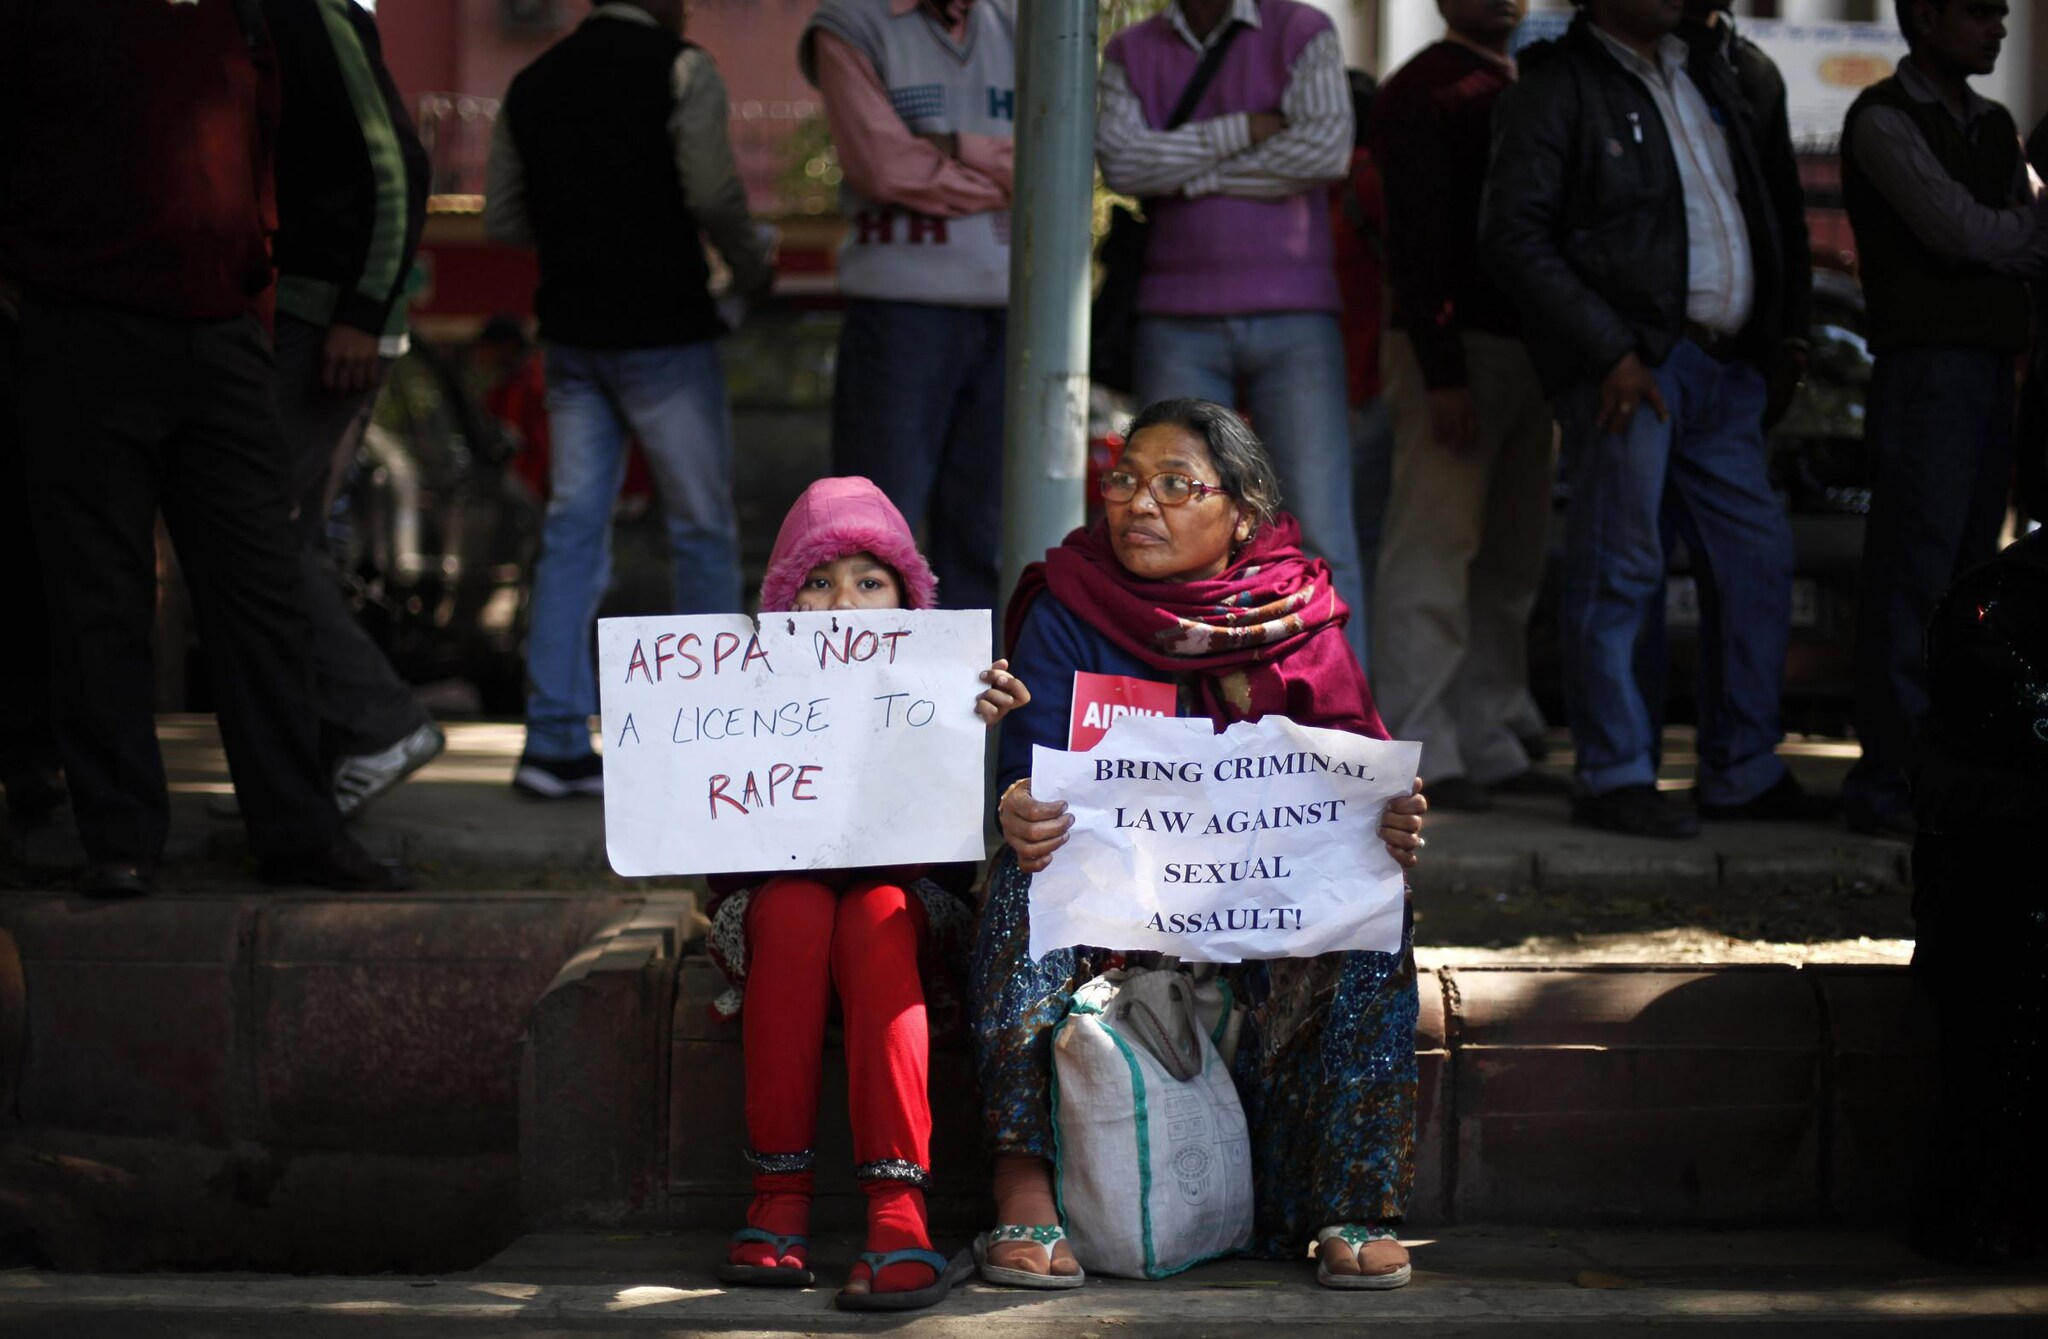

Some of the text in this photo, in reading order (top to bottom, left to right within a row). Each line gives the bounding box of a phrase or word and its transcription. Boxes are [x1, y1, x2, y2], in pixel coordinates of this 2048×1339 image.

[626, 627, 913, 684] AFSPA NOT
[618, 693, 936, 747] A LICENSE TO
[1094, 752, 1375, 783] BRING CRIMINAL
[708, 763, 824, 819] RAPE
[1115, 800, 1346, 835] LAW AGAINST
[1163, 856, 1291, 884] SEXUAL
[1145, 909, 1302, 934] ASSAULT!
